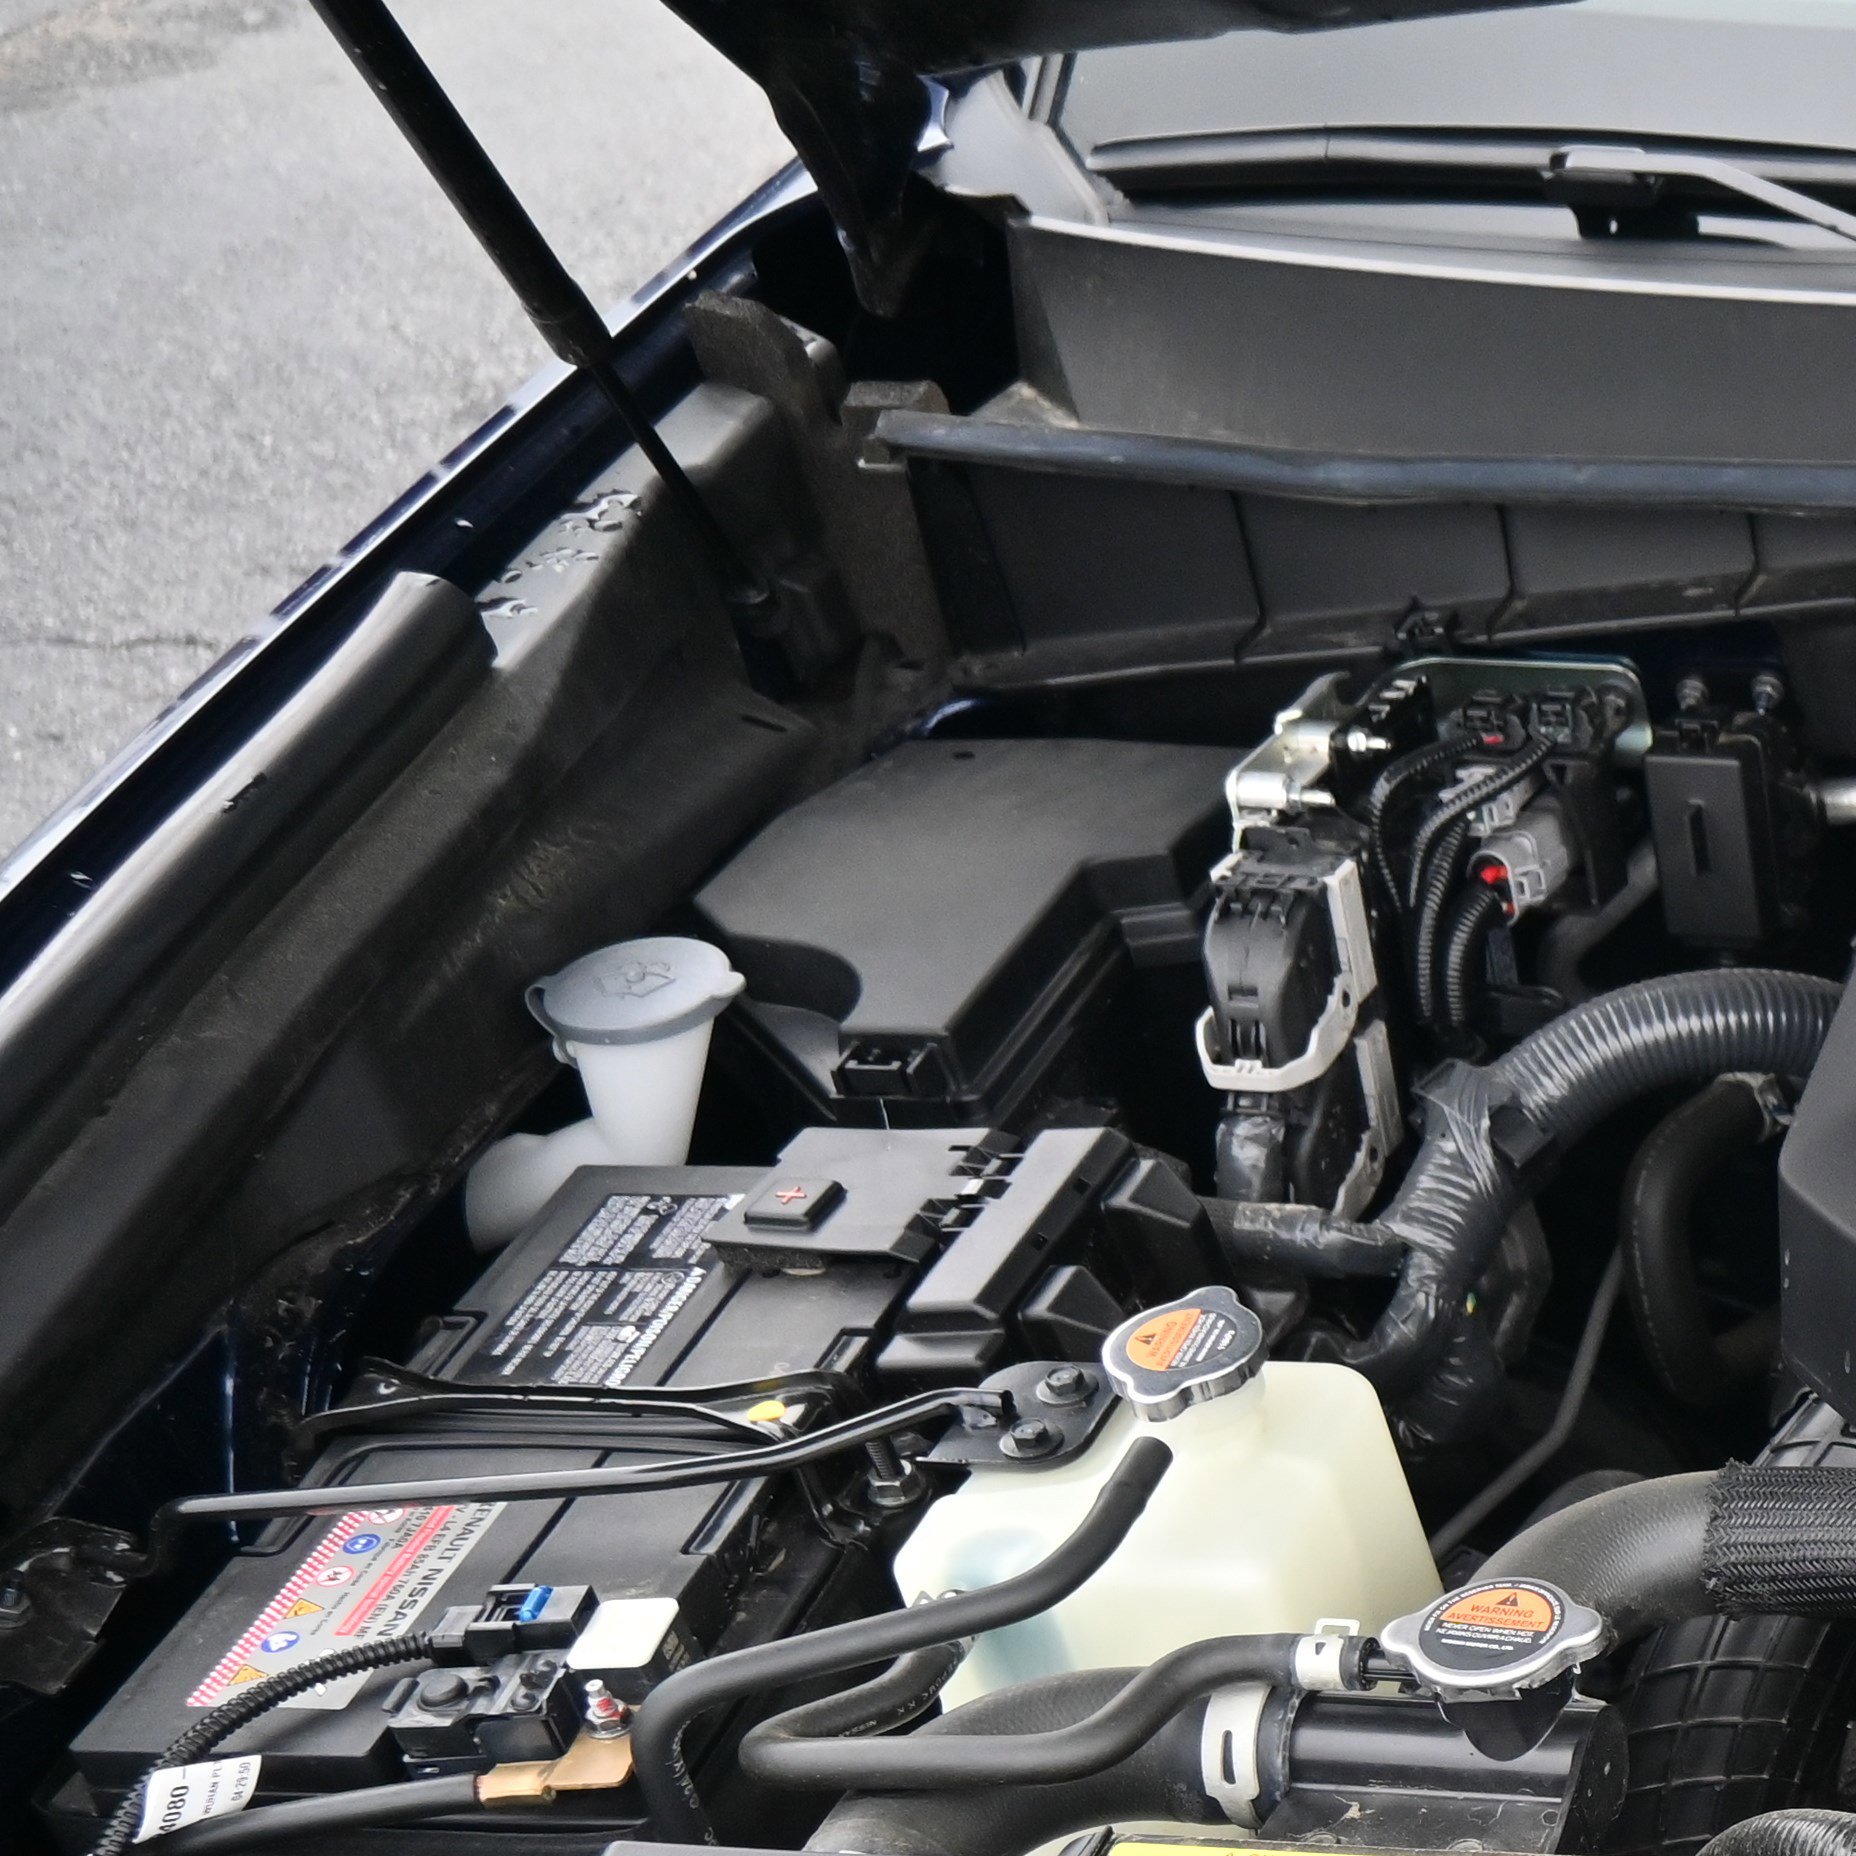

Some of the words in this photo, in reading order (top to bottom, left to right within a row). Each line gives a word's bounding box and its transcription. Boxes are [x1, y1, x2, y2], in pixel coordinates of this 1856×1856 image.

[378, 1568, 444, 1636] NISSAN
[1470, 1604, 1535, 1619] WARNING
[1448, 1612, 1544, 1629] AVERTISSEMENT
[1469, 1623, 1490, 1633] OPEN
